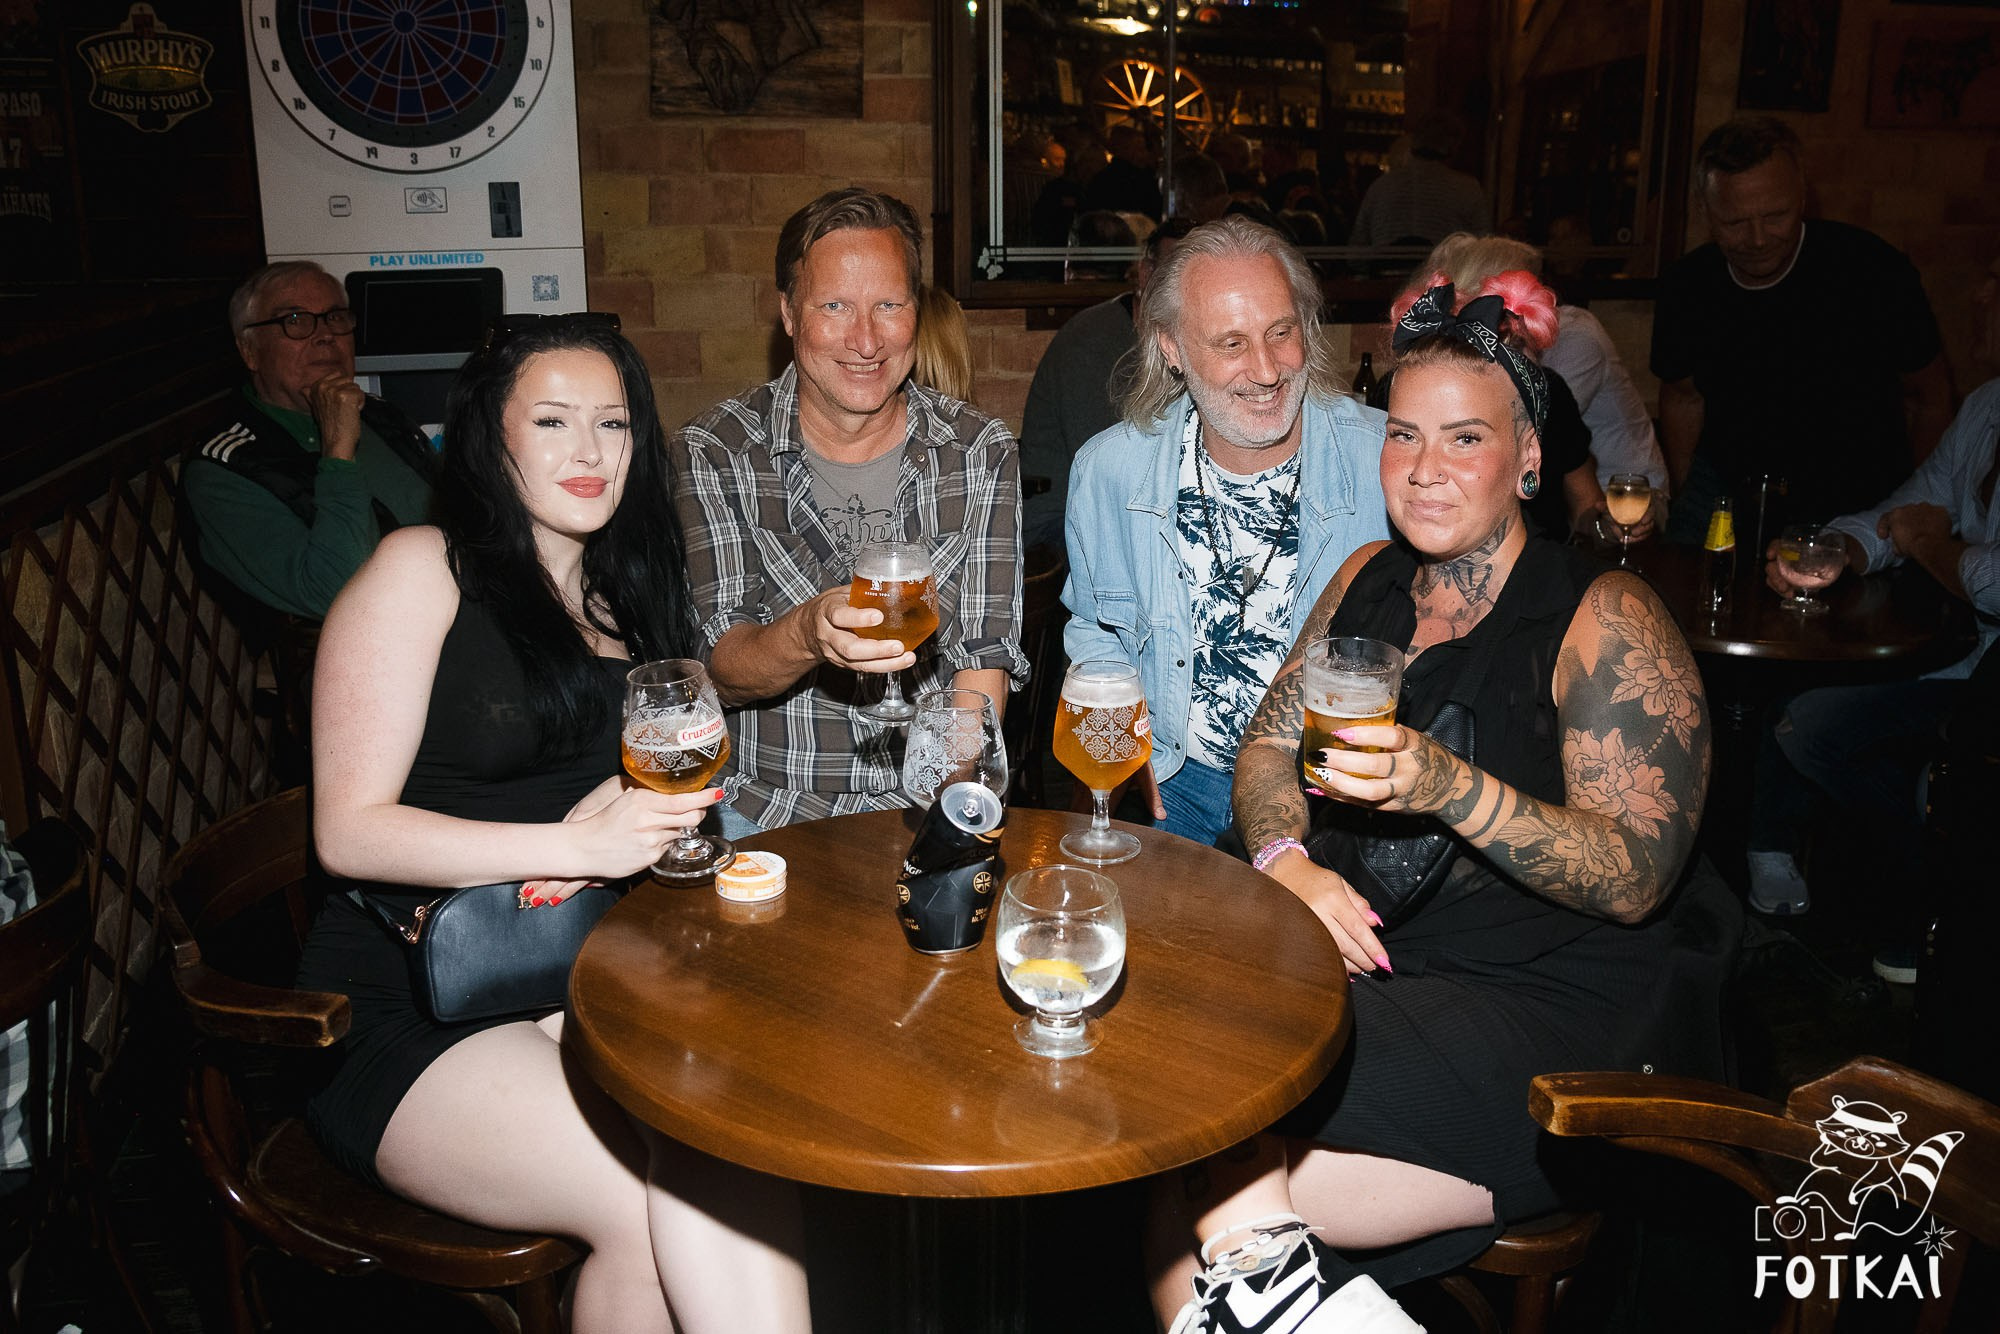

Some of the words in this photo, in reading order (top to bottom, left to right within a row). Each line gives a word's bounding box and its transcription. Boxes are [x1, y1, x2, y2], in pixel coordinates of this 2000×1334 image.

[260, 16, 270, 28] 11
[536, 16, 544, 28] 6
[271, 59, 280, 72] 8
[530, 58, 542, 70] 10
[101, 89, 147, 111] IRISH
[149, 88, 201, 111] STOUT
[293, 98, 306, 110] 16
[513, 97, 525, 108] 15
[328, 128, 336, 140] 7
[487, 126, 495, 138] 2
[365, 146, 378, 159] 19
[449, 146, 461, 158] 17
[410, 152, 418, 165] 3
[369, 255, 404, 267] PLAY
[409, 252, 485, 266] UNLIMITED
